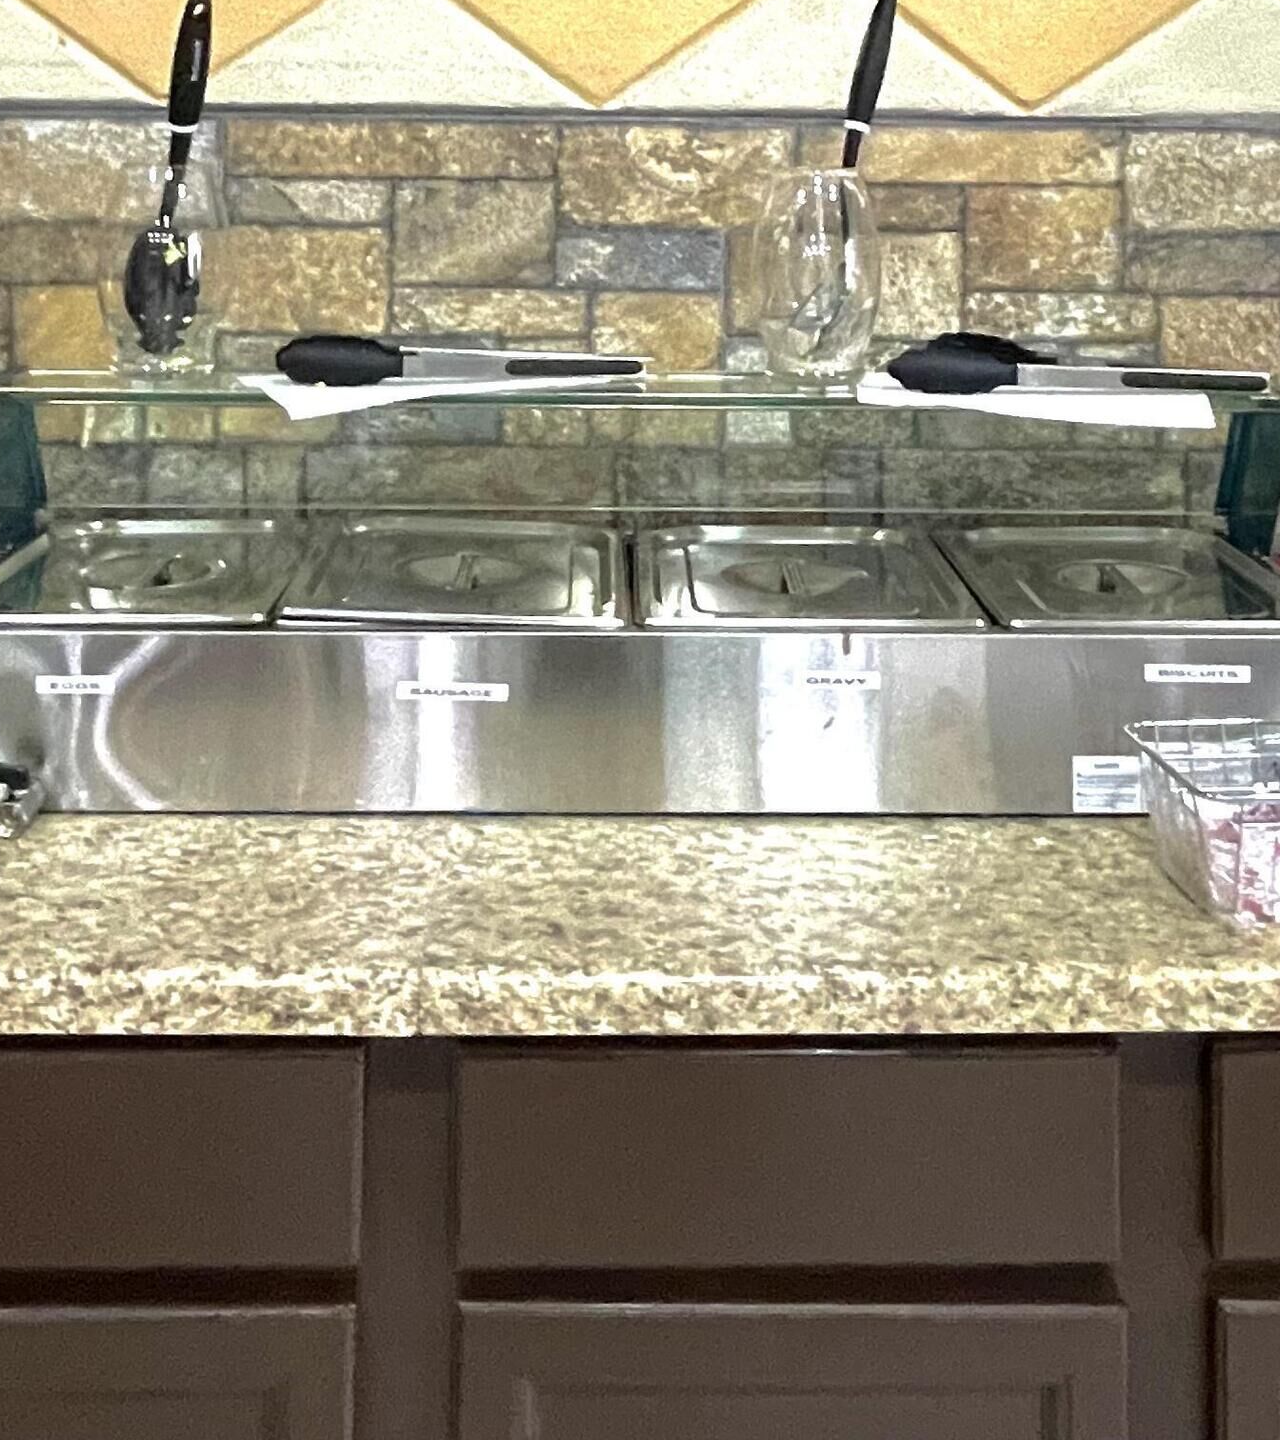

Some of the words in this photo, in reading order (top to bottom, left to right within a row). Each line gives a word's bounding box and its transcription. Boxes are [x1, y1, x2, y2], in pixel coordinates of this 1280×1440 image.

[49, 681, 101, 690] EGGS
[806, 676, 867, 686] GRAVY
[409, 687, 493, 698] SAUSAGE
